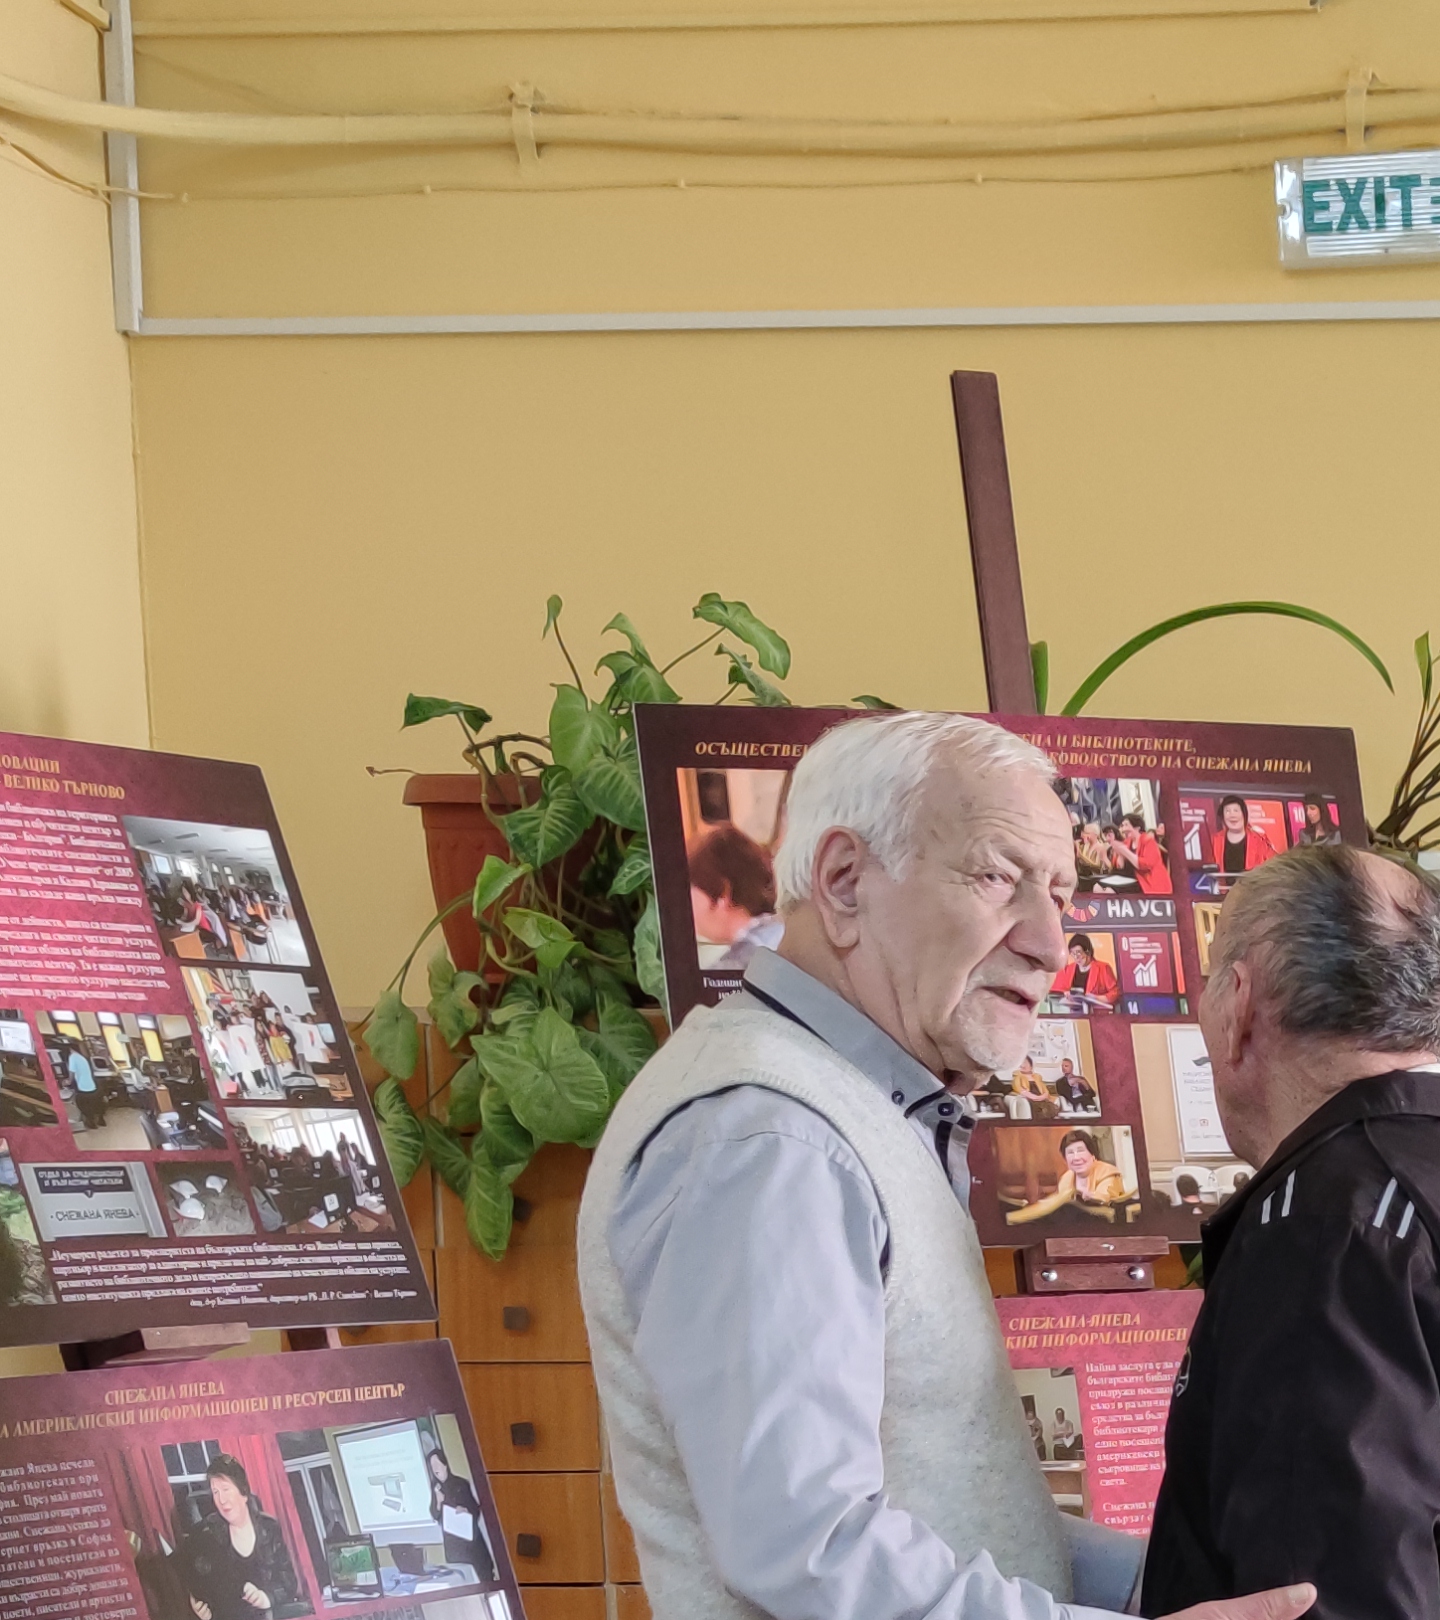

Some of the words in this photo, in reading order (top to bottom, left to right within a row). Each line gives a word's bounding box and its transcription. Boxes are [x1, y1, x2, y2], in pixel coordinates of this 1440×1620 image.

[1303, 174, 1421, 232] EXIT
[695, 742, 809, 757] ОСЪЩЕСТВЕ
[1050, 752, 1157, 769] КОВОДСТВОТО
[3, 773, 60, 792] ВЕЛИКО
[62, 780, 125, 799] ТЪРНОВО
[1106, 899, 1134, 918] НА
[1009, 1314, 1085, 1331] СНЕЖАНА
[1087, 1312, 1140, 1326] ЯНЕВА
[104, 1385, 175, 1405] СНЕЖАНА
[179, 1380, 225, 1398] ЯНЕВА
[13, 1410, 134, 1436] АМЕРИКАНСКИЯ
[139, 1396, 268, 1423] ИНФОРМАЦИОНЕН
[272, 1395, 282, 1410] И
[285, 1388, 351, 1408] РЕСУРСЕН
[354, 1383, 405, 1401] ЦЕНТЪР
